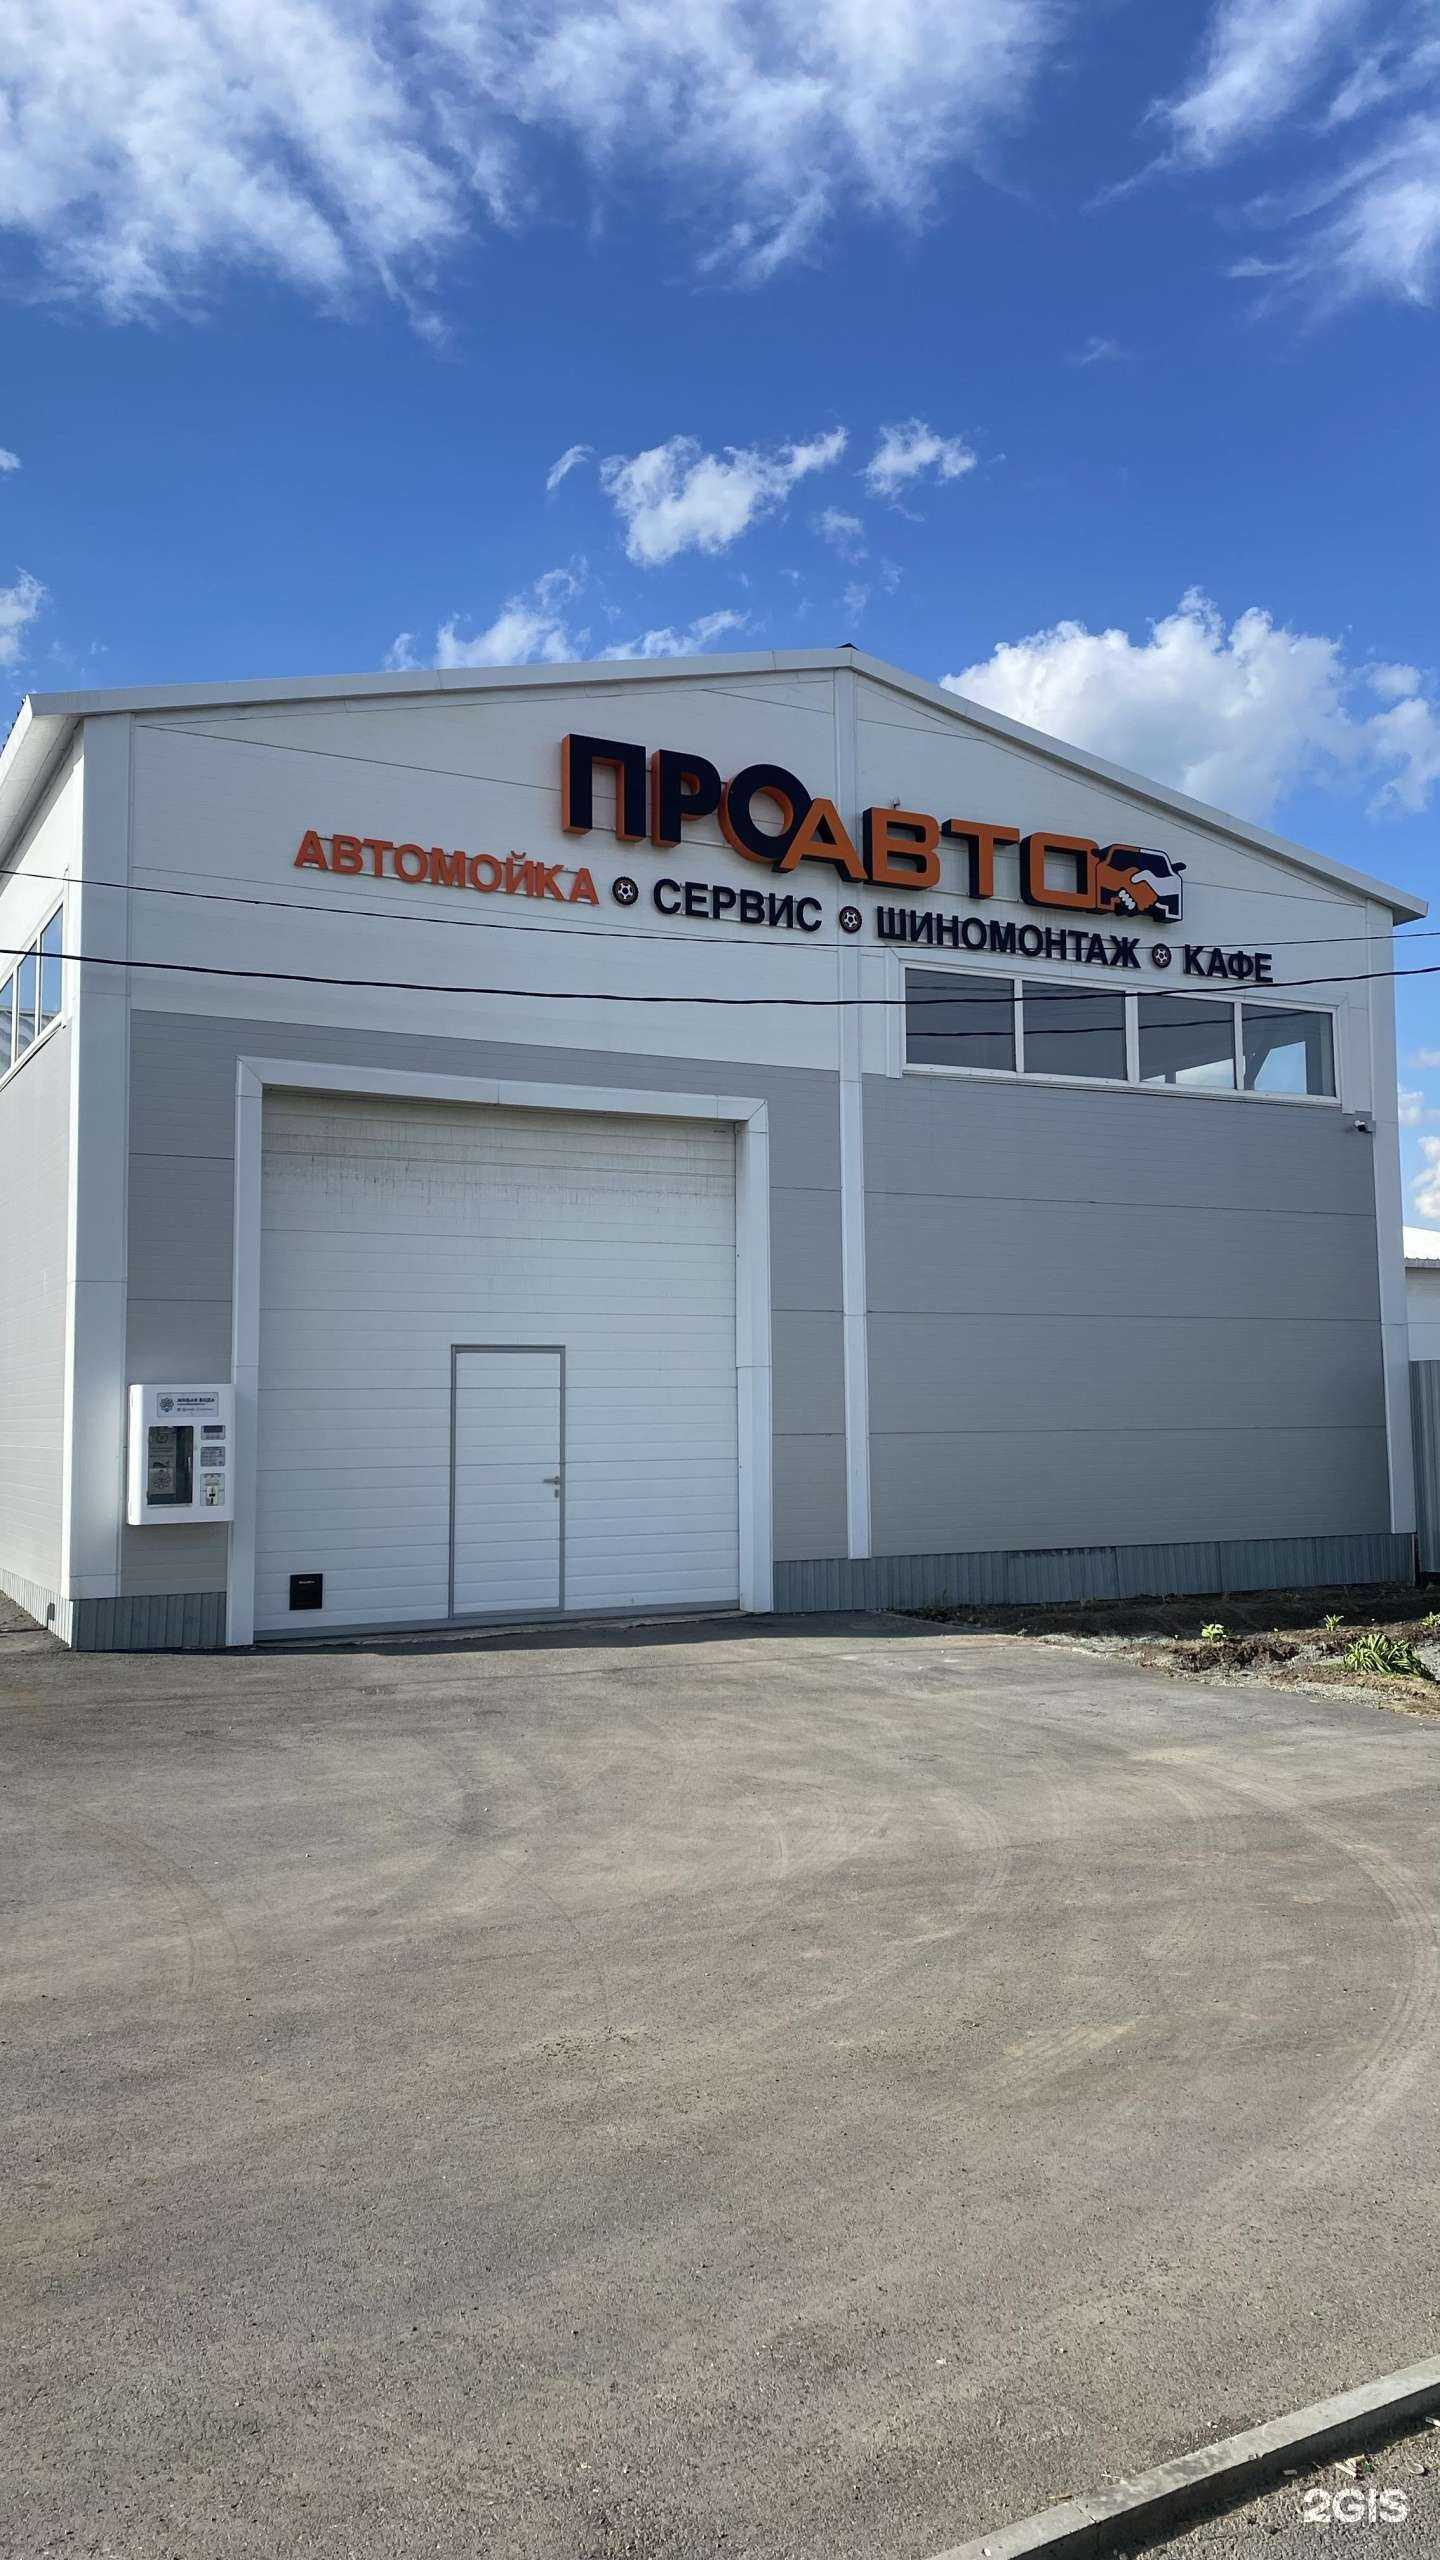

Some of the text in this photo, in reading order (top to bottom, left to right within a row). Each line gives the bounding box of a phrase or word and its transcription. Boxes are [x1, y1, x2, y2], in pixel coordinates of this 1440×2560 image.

[294, 829, 1273, 983] АВТОМОЙКА СЕРВИС ШИНОМОНТАЖ КАФЕ
[561, 733, 1100, 915] ПРОАВТО
